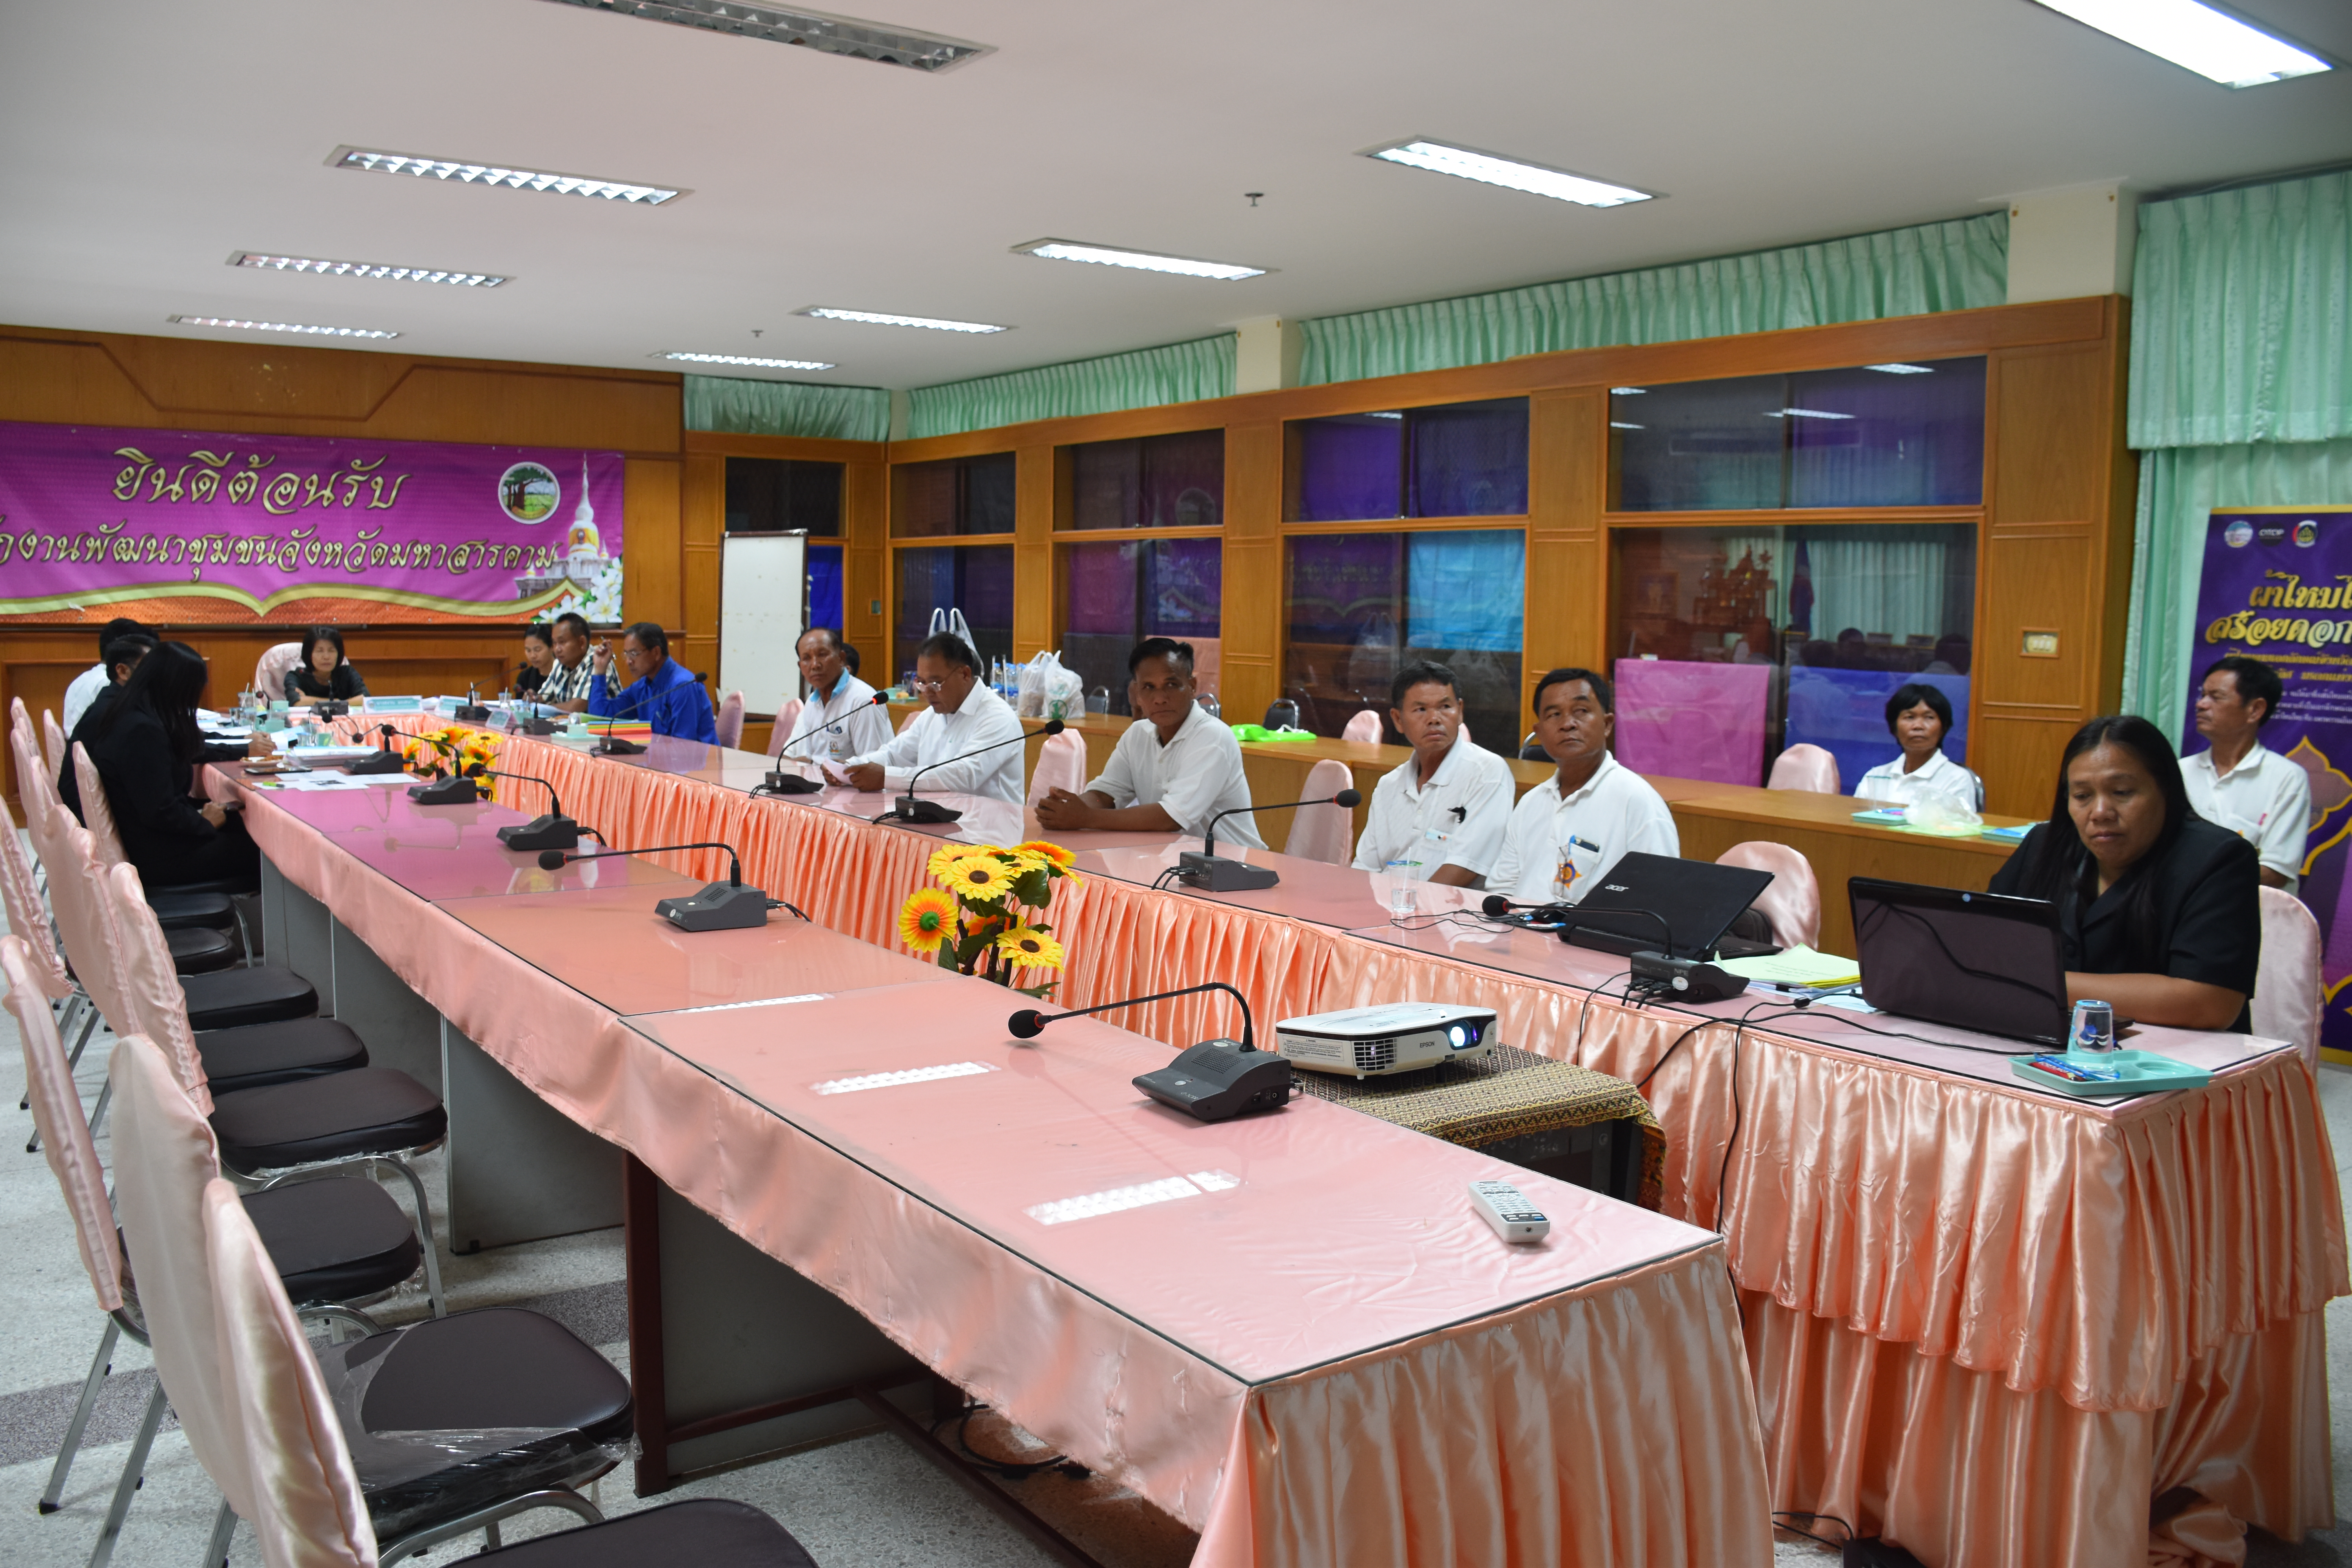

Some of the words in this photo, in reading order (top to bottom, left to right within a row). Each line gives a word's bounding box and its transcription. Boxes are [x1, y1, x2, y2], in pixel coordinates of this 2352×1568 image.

[113, 447, 412, 514] ยินดีต้อนรับ
[0, 515, 563, 582] กงานพัฒนาชุมชนจังหวัดมหาสารคาม
